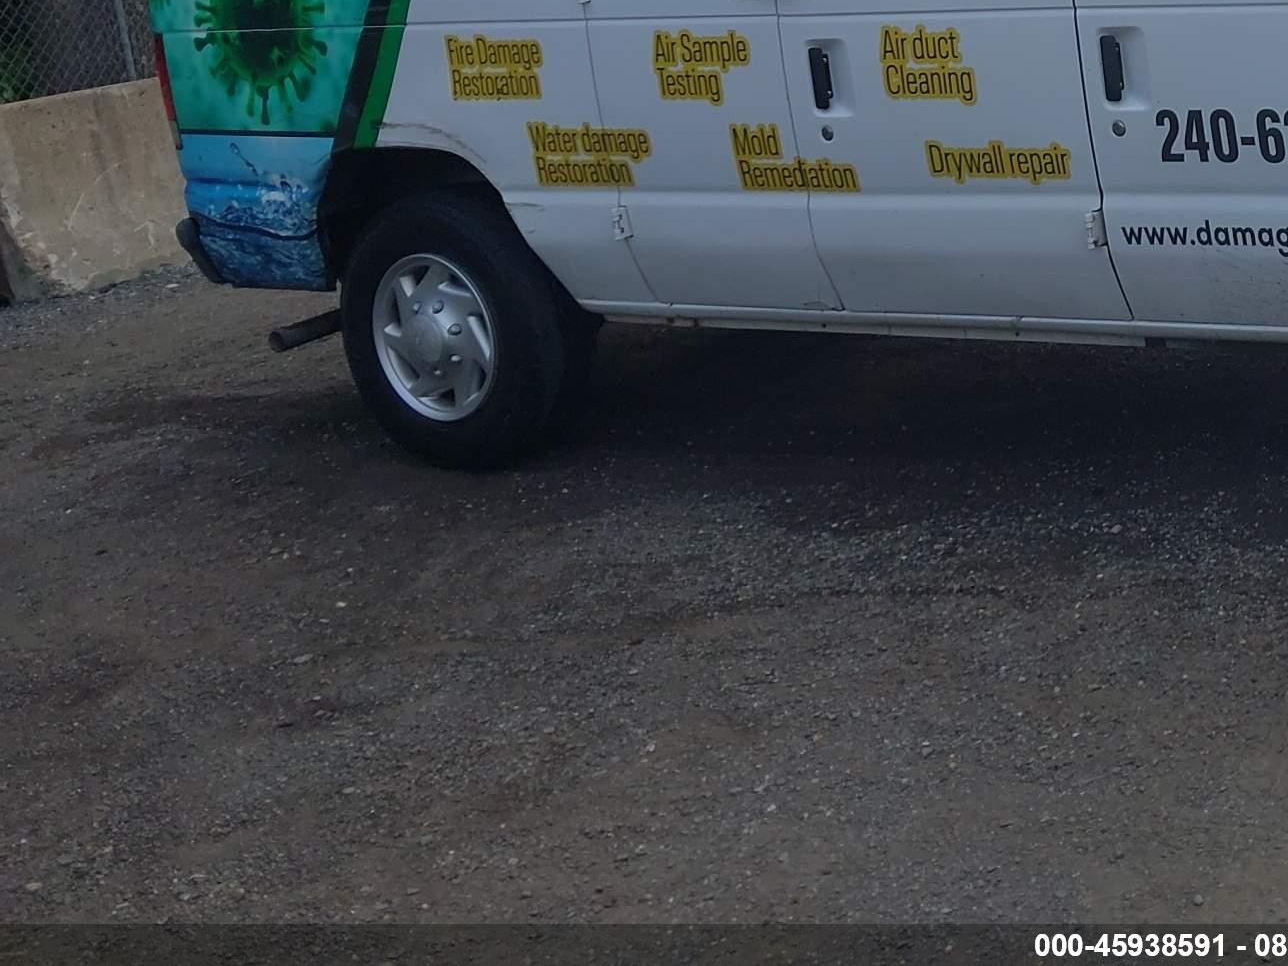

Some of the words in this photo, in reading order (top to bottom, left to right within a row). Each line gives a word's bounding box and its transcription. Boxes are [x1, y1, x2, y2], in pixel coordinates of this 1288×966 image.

[447, 38, 474, 65] Fire
[476, 37, 541, 70] Damage
[656, 34, 676, 63] Air
[680, 32, 748, 69] Sample
[883, 29, 907, 60] Air
[912, 28, 958, 60] duct
[452, 69, 540, 97] Restoration
[656, 66, 721, 103] Testing
[886, 63, 974, 102] Cleaning
[527, 123, 577, 153] Water
[581, 124, 649, 160] damage
[731, 127, 780, 156] Mold
[536, 156, 634, 184] Restoration
[739, 158, 858, 189] Remediation
[928, 144, 1005, 180] Drywall
[1008, 146, 1068, 181] repair
